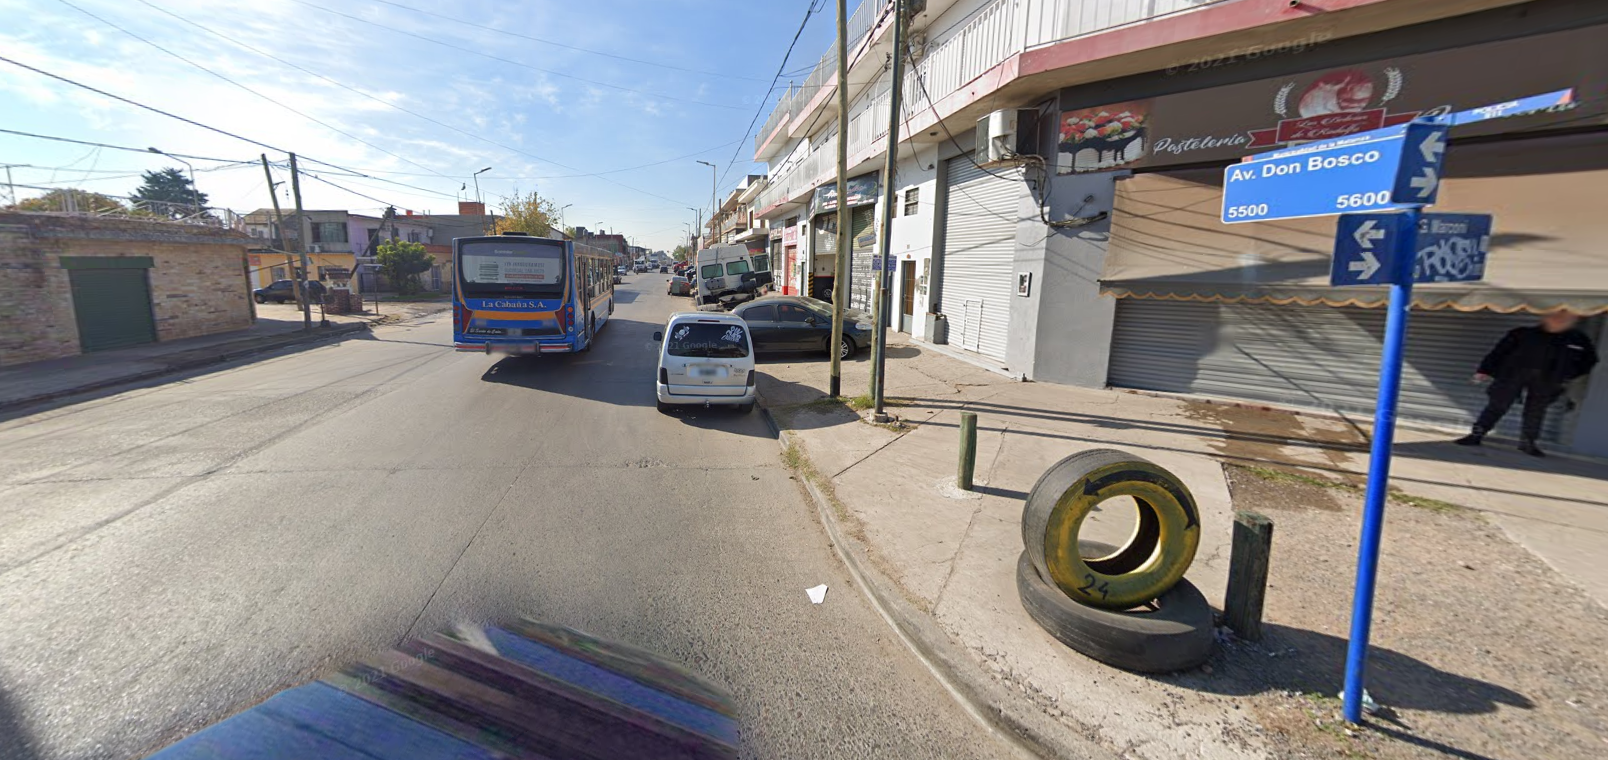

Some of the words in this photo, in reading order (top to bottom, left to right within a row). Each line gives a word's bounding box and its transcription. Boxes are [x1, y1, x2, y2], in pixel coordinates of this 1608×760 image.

[1230, 168, 1256, 183] Av.
[1261, 161, 1301, 179] Don
[1307, 150, 1381, 171] Bosco
[1228, 203, 1269, 218] 5500
[1336, 190, 1391, 209] 5600
[495, 300, 528, 308] Cabaña
[528, 301, 547, 309] S.A.
[1077, 573, 1109, 600] 24
